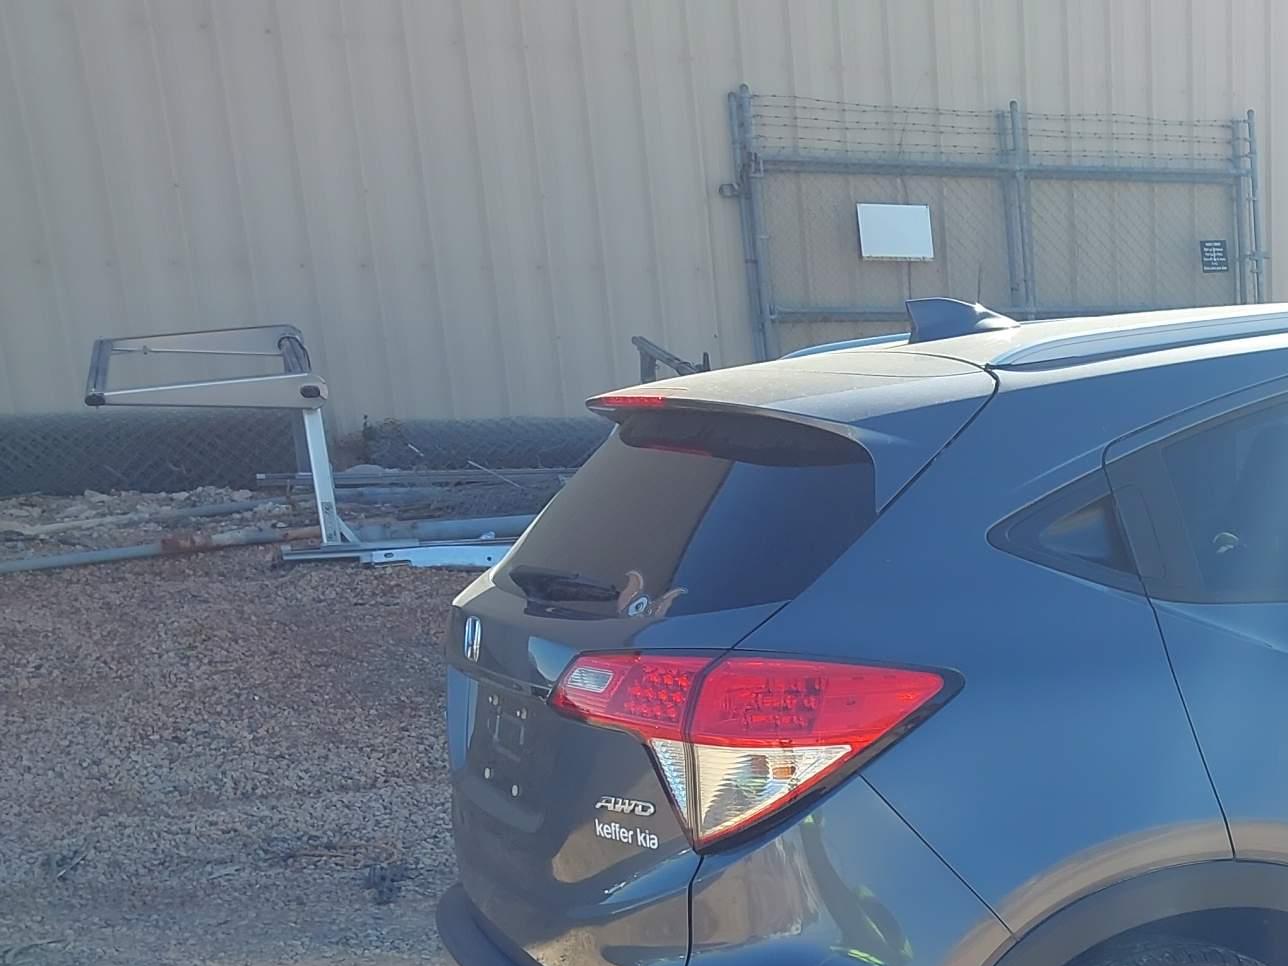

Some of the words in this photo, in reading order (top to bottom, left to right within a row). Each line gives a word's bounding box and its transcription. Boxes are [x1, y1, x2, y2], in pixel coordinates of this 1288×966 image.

[595, 796, 655, 816] AWD
[594, 818, 634, 844] keffer
[636, 828, 659, 850] kia
